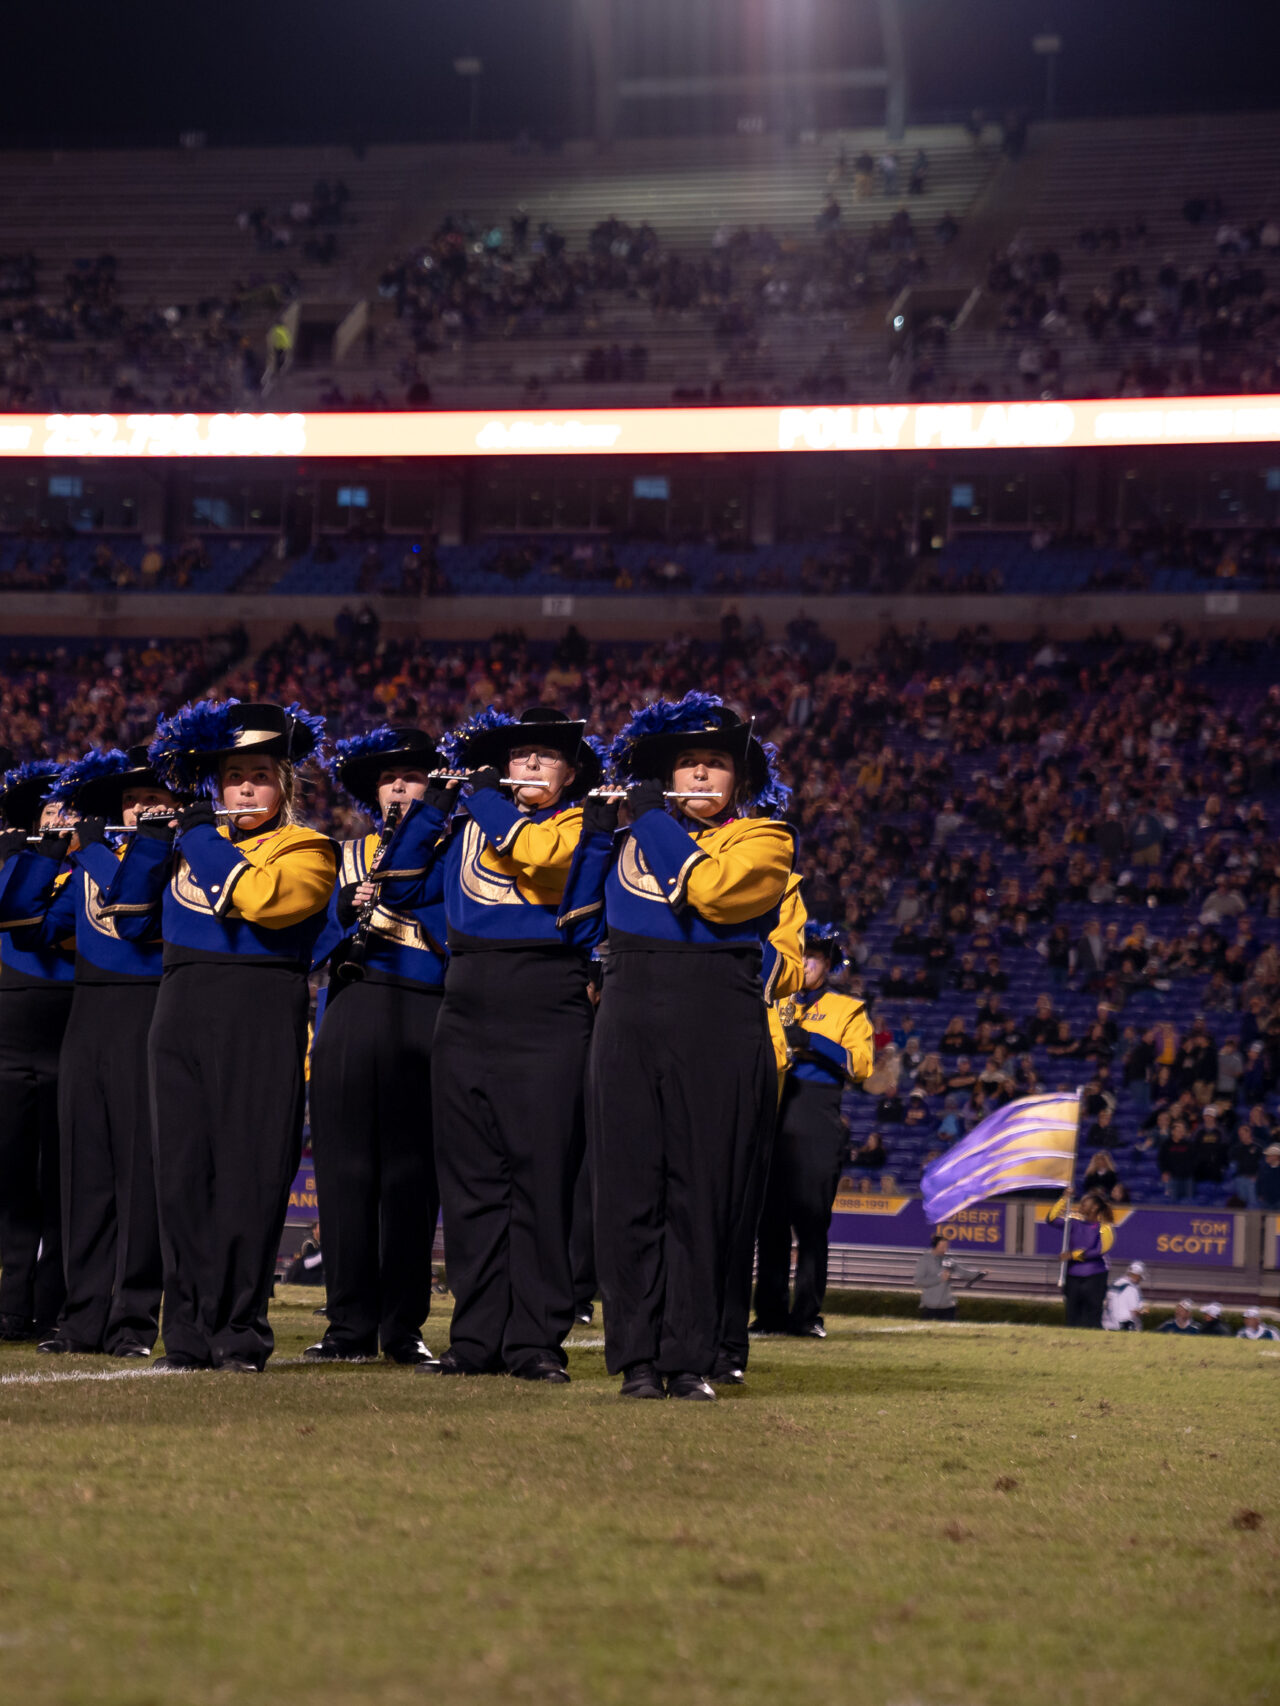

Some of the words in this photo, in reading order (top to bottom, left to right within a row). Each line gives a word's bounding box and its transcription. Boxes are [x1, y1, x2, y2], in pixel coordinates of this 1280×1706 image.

[778, 406, 899, 449] POLLY
[1190, 1219, 1229, 1235] TOM
[1156, 1235, 1228, 1254] SCOTT
